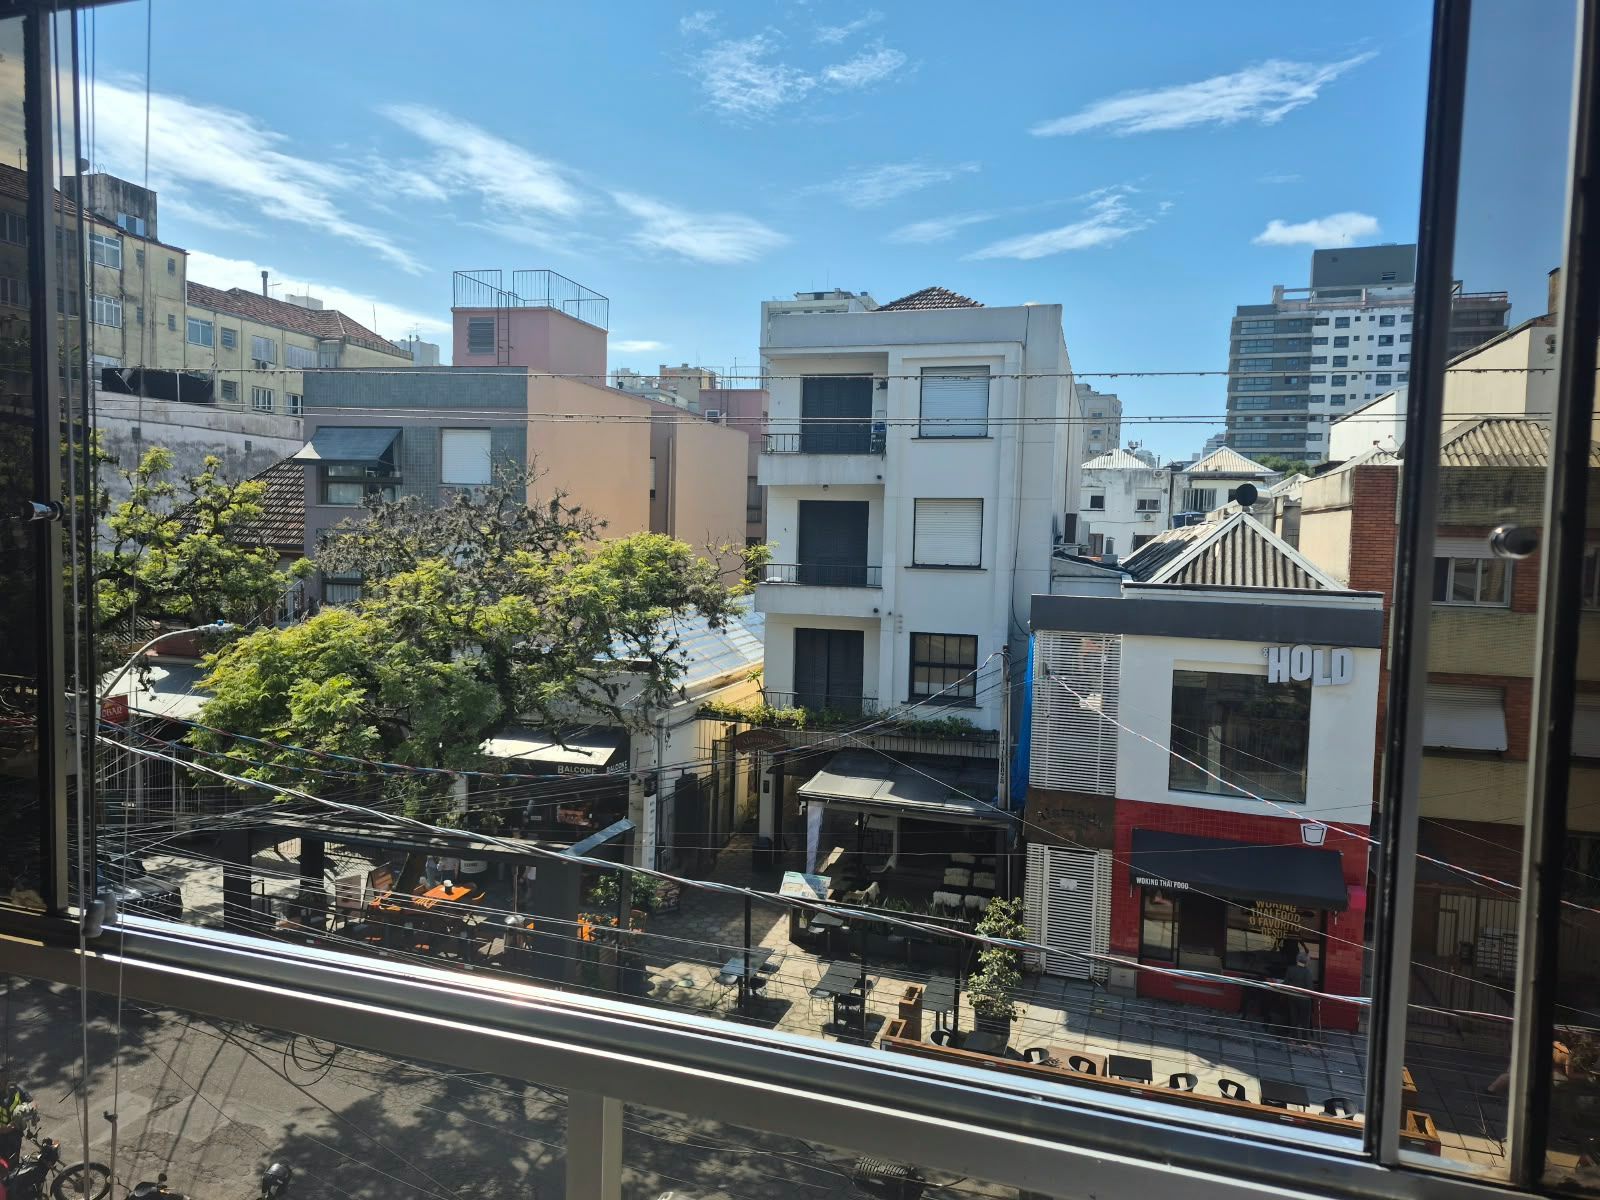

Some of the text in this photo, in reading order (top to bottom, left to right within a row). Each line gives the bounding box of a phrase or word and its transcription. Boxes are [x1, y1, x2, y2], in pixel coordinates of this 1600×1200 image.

[1267, 644, 1354, 687] HOLD
[557, 765, 598, 775] BALCONE
[1136, 876, 1159, 886] WOKING
[1274, 909, 1301, 923] FOOD
